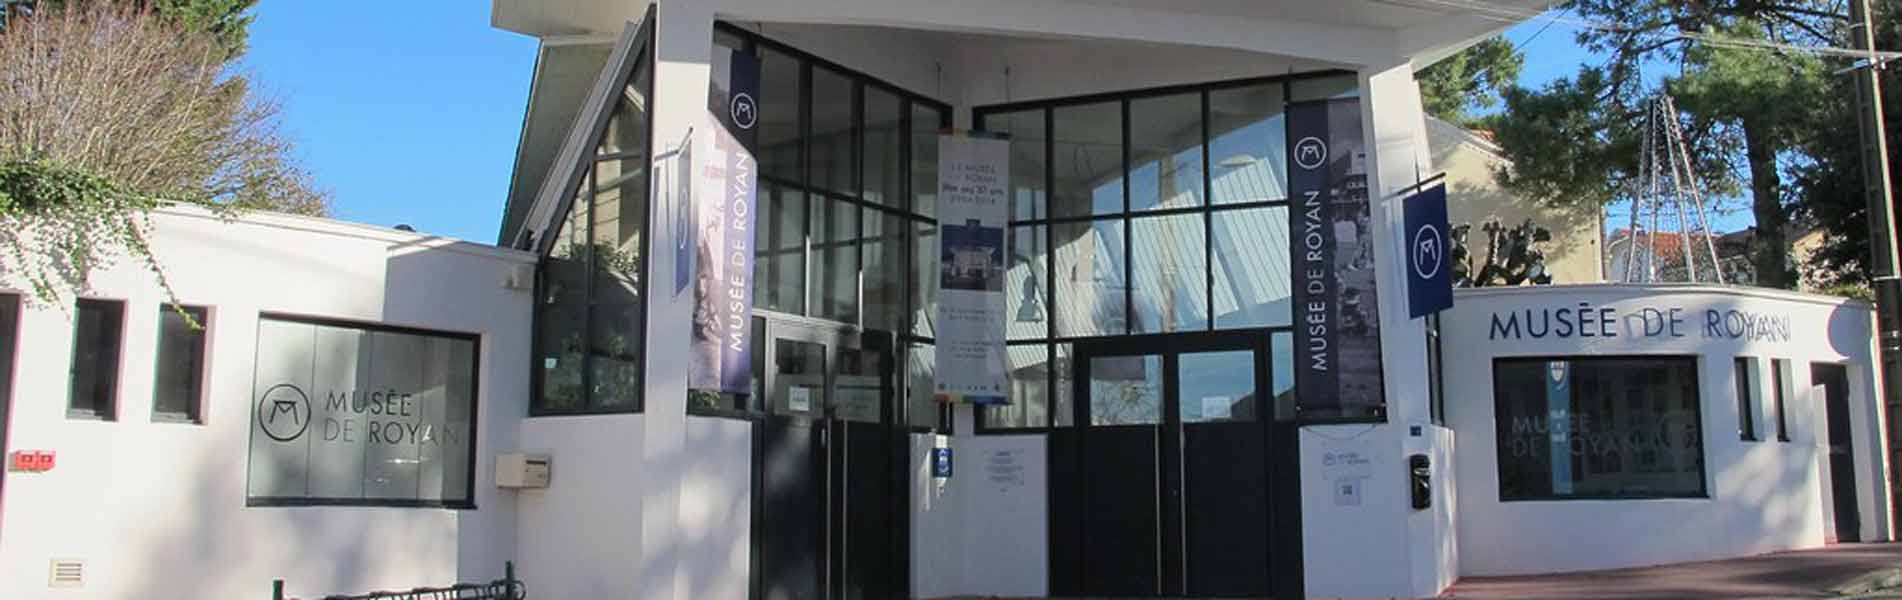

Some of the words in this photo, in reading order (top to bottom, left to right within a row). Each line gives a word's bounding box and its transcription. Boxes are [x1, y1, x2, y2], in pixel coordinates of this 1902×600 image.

[732, 151, 749, 232] ROYAN
[1304, 190, 1324, 262] ROYAN
[731, 239, 747, 266] DE
[1306, 268, 1325, 294] DE
[728, 273, 746, 352] MUSÉE
[1488, 302, 1617, 340] MUSÉE
[1642, 307, 1685, 338] DE
[1706, 309, 1790, 342] ROYAN
[1306, 301, 1328, 371] MUSÉE
[324, 388, 413, 417] MUSÉE
[323, 418, 355, 442] DE
[368, 421, 459, 446] ROYAN
[1512, 435, 1542, 457] DE
[1552, 434, 1641, 457] OYAN
